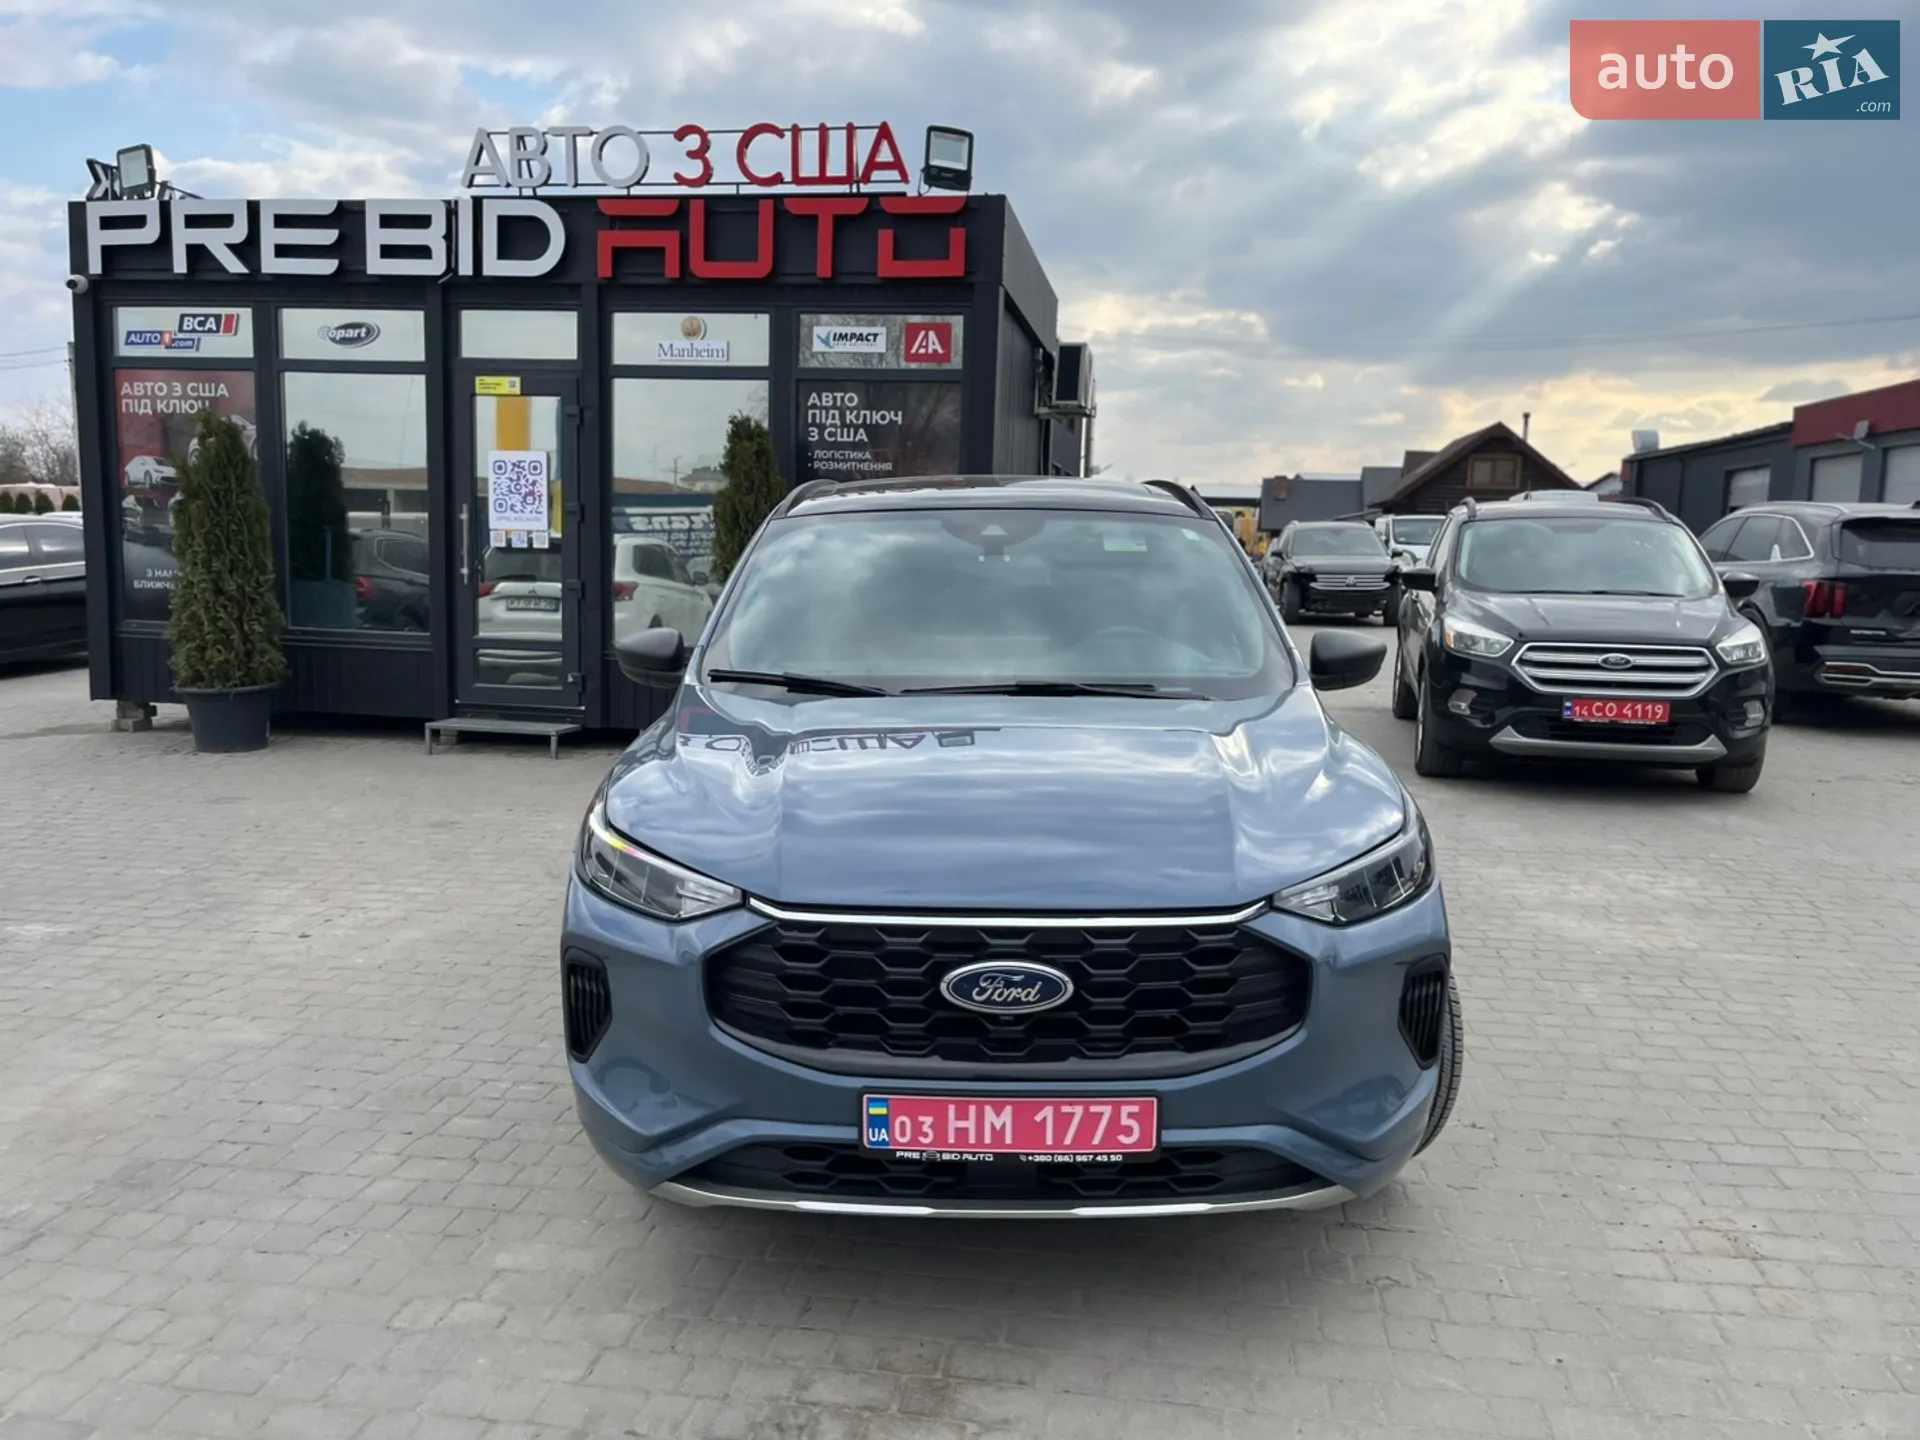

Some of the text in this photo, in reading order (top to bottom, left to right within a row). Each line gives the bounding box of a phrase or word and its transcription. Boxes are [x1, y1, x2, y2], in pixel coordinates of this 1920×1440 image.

[461, 125, 650, 189] АВТО
[736, 120, 911, 187] США
[86, 196, 967, 279] PRE BID AUTO
[182, 316, 217, 331] BCA
[832, 332, 879, 343] IMPACT
[657, 343, 725, 359] Manheim
[120, 382, 167, 396] АВТО
[186, 383, 229, 397] США
[121, 399, 152, 415] ПІД
[807, 392, 858, 407] АВТО
[807, 409, 902, 426] ПІД КЛЮЧ
[824, 428, 868, 443] США
[813, 461, 893, 471] РОЗМИТНЕННЯ
[1622, 703, 1664, 719] 4119
[972, 973, 1042, 1002] Ford
[894, 1104, 1141, 1145] 03 HM 1775
[868, 1127, 889, 1142] UA
[896, 1150, 920, 1159] PRE
